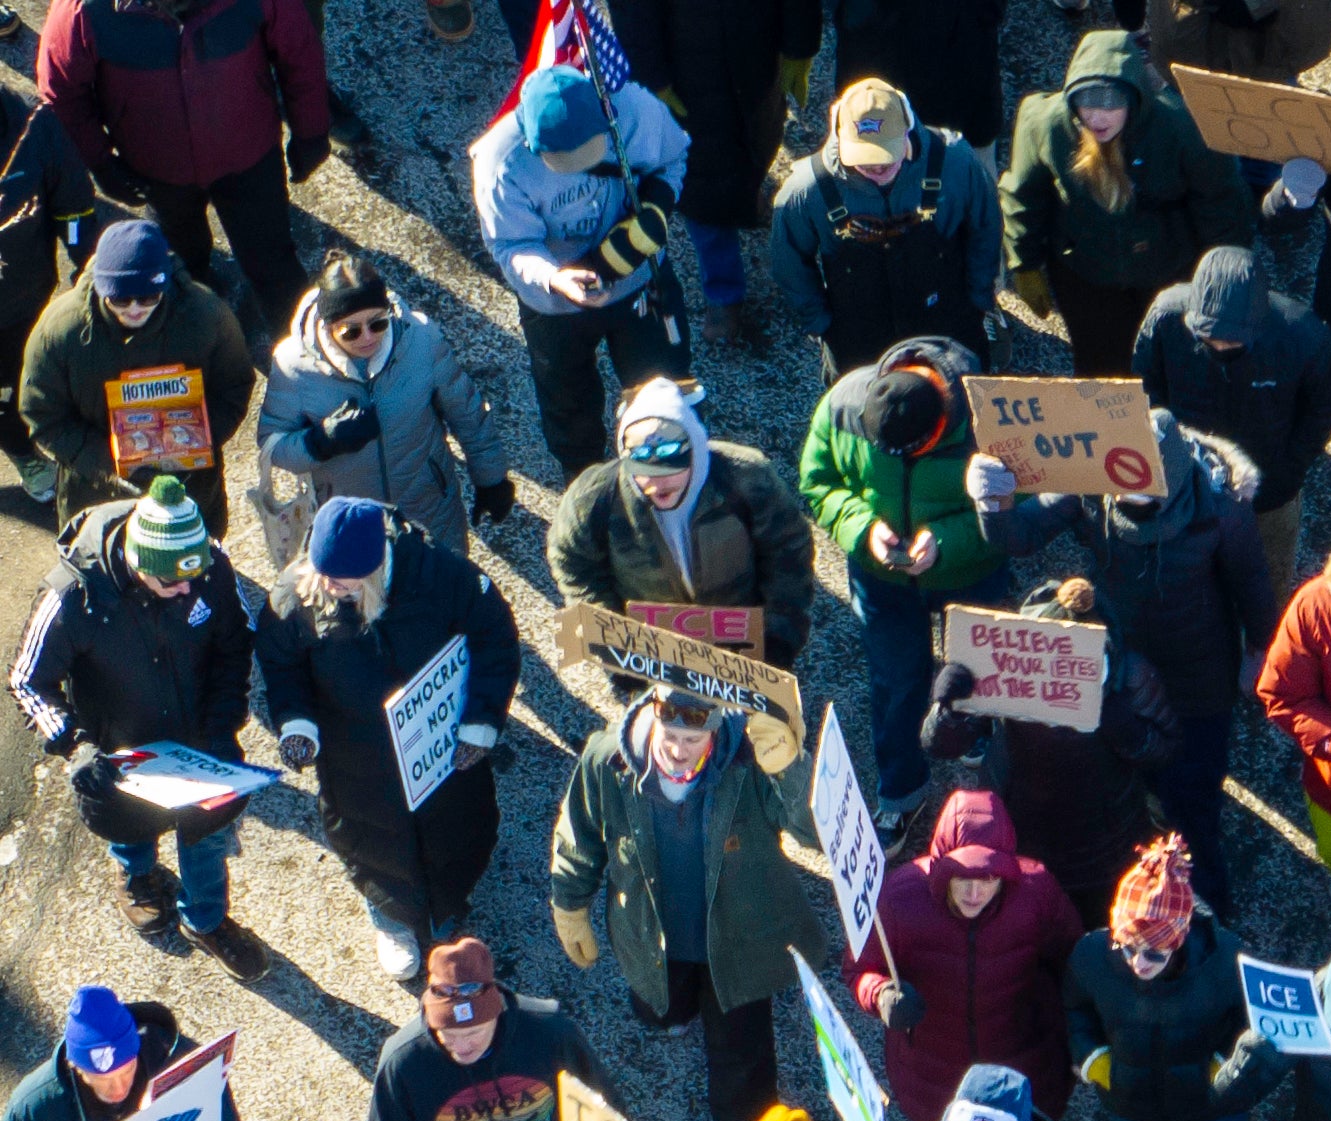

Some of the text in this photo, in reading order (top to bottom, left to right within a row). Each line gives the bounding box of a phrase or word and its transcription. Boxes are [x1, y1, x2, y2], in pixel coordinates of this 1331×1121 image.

[991, 397, 1045, 426] ICE
[1034, 432, 1099, 459] OUT
[629, 604, 748, 642] ICE
[971, 624, 1073, 655] BELIEVE
[594, 613, 665, 647] SPEAK
[678, 639, 719, 663] YOUR
[724, 653, 780, 685] MIND
[992, 652, 1099, 678] YOUR EYES
[396, 645, 468, 731] DEMOCRAC
[608, 645, 767, 713] VOICE SHAKES
[673, 648, 690, 667] IF
[712, 662, 760, 691] YOUR
[1003, 677, 1036, 698] THE
[1041, 682, 1082, 702] LIES
[427, 692, 455, 733] NOT
[412, 722, 459, 781] OLIGAR
[841, 808, 865, 890] Your
[853, 842, 878, 932] Eyes
[1259, 980, 1301, 1010] ICE
[1259, 1015, 1314, 1038] OUT
